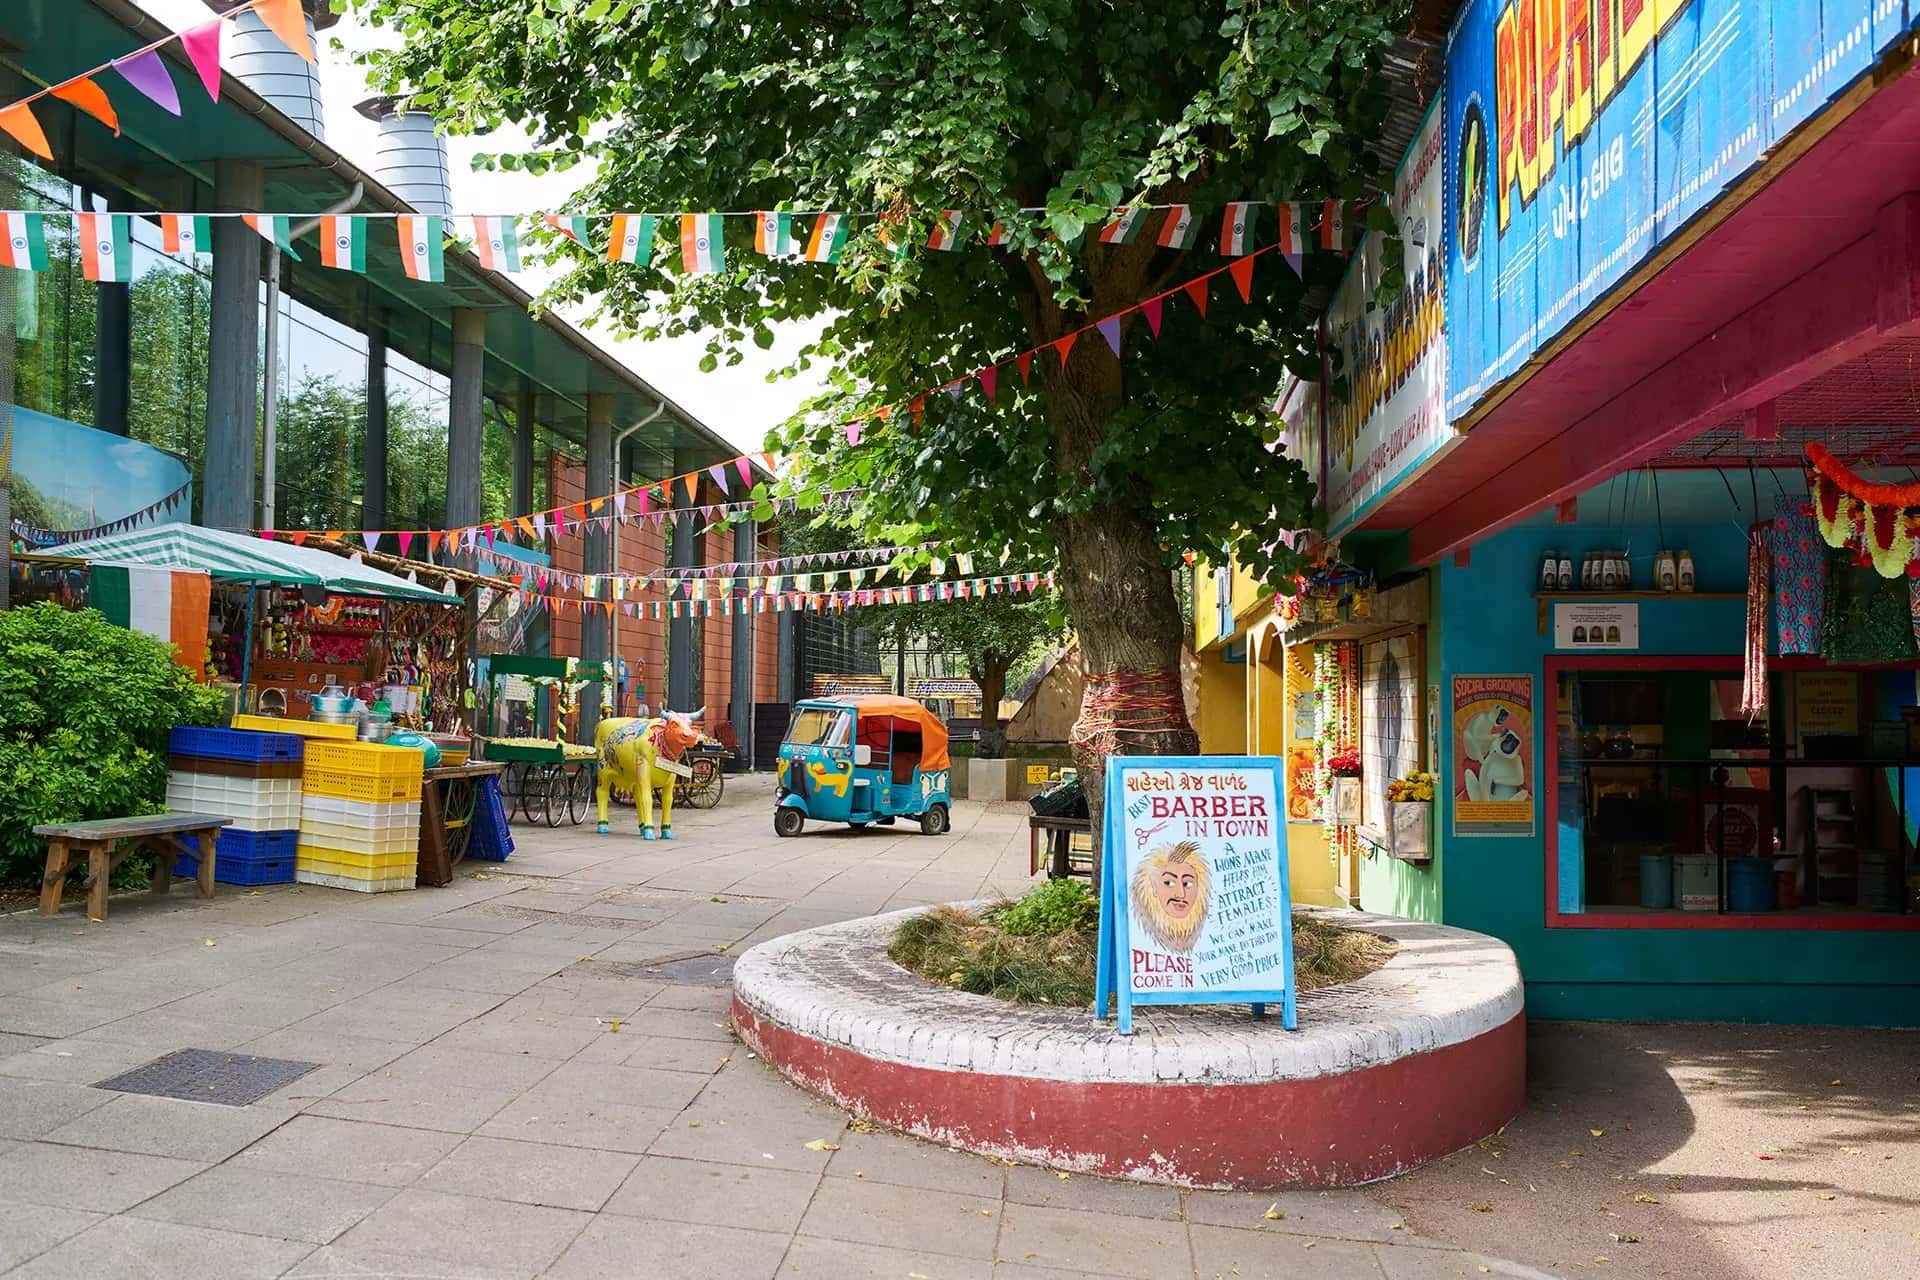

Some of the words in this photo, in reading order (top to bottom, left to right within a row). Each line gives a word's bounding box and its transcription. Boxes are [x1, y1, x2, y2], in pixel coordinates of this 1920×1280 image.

[1456, 679, 1485, 698] SOCIAL
[1487, 679, 1530, 699] GROOMING
[1128, 793, 1152, 819] BEST
[1152, 796, 1268, 818] BARBER
[1186, 820, 1208, 837] IN
[1214, 820, 1269, 837] TOWN
[1224, 842, 1236, 855] A
[1243, 848, 1272, 868] MANE
[1223, 869, 1249, 887] HELPS
[1252, 864, 1268, 878] HIM
[1218, 880, 1265, 909] ATTRACT
[1217, 896, 1273, 925] FEMALES
[1209, 934, 1225, 945] WE
[1228, 927, 1245, 939] CAN
[1249, 918, 1275, 933] MAKE
[1132, 948, 1193, 973] PLEASE
[1194, 950, 1217, 964] YOUR
[1218, 943, 1237, 957] MANE
[1229, 953, 1245, 966] FOR
[1247, 951, 1254, 960] A
[1200, 966, 1229, 987] VERY
[1231, 961, 1254, 982] GOOD
[1255, 952, 1281, 974] PRICE
[1133, 975, 1173, 988] COME
[1180, 975, 1193, 988] IN
